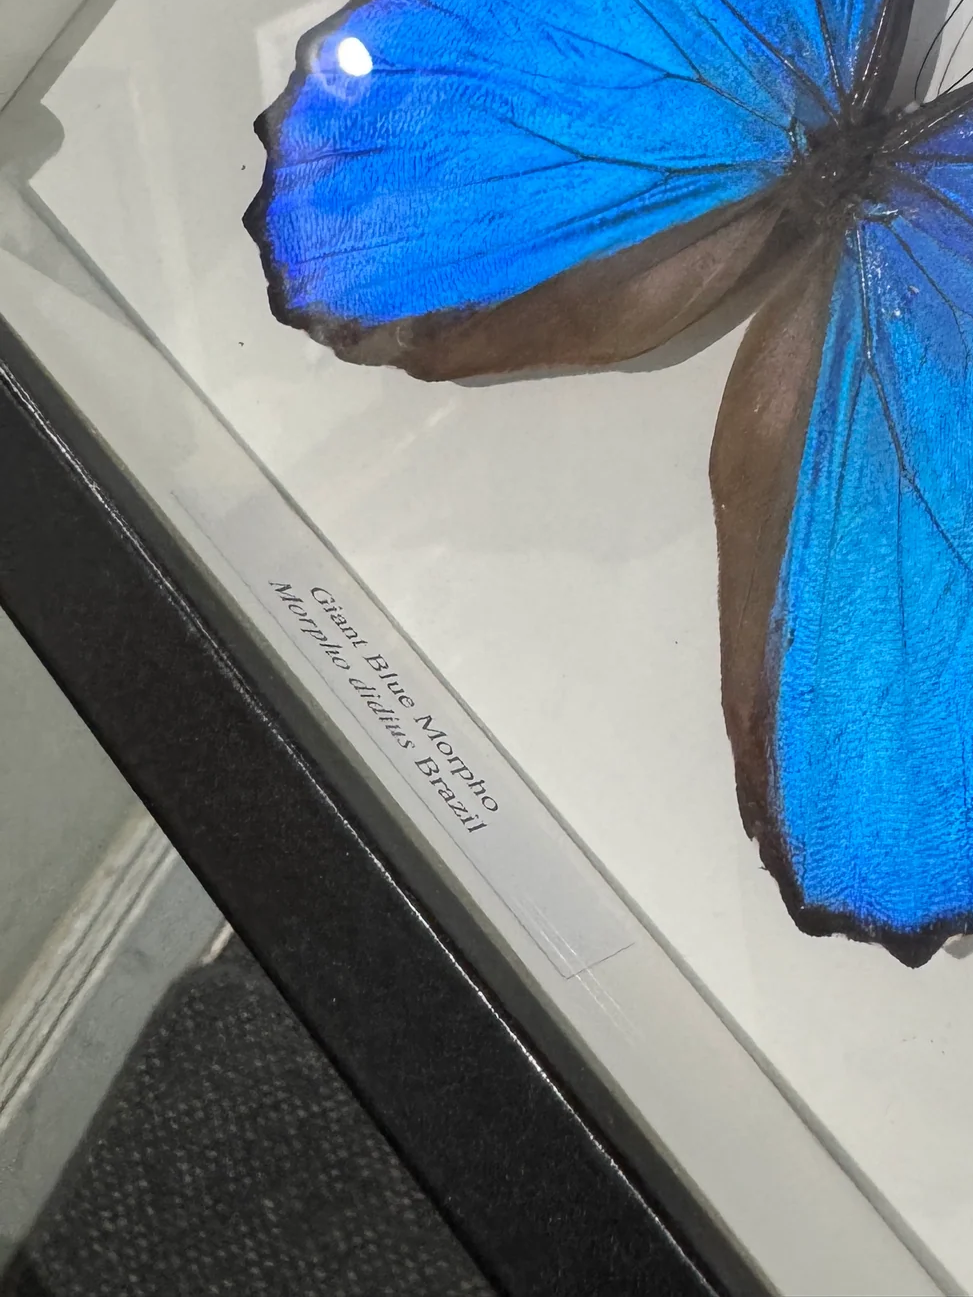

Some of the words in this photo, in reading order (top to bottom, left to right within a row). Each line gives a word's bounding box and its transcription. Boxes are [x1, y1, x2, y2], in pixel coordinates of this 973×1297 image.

[268, 580, 350, 671] Morpho
[349, 677, 416, 750] didius
[415, 756, 487, 833] Brazil
[310, 586, 368, 648] Giant
[364, 654, 415, 708] Blue
[414, 714, 499, 812] Morpho
